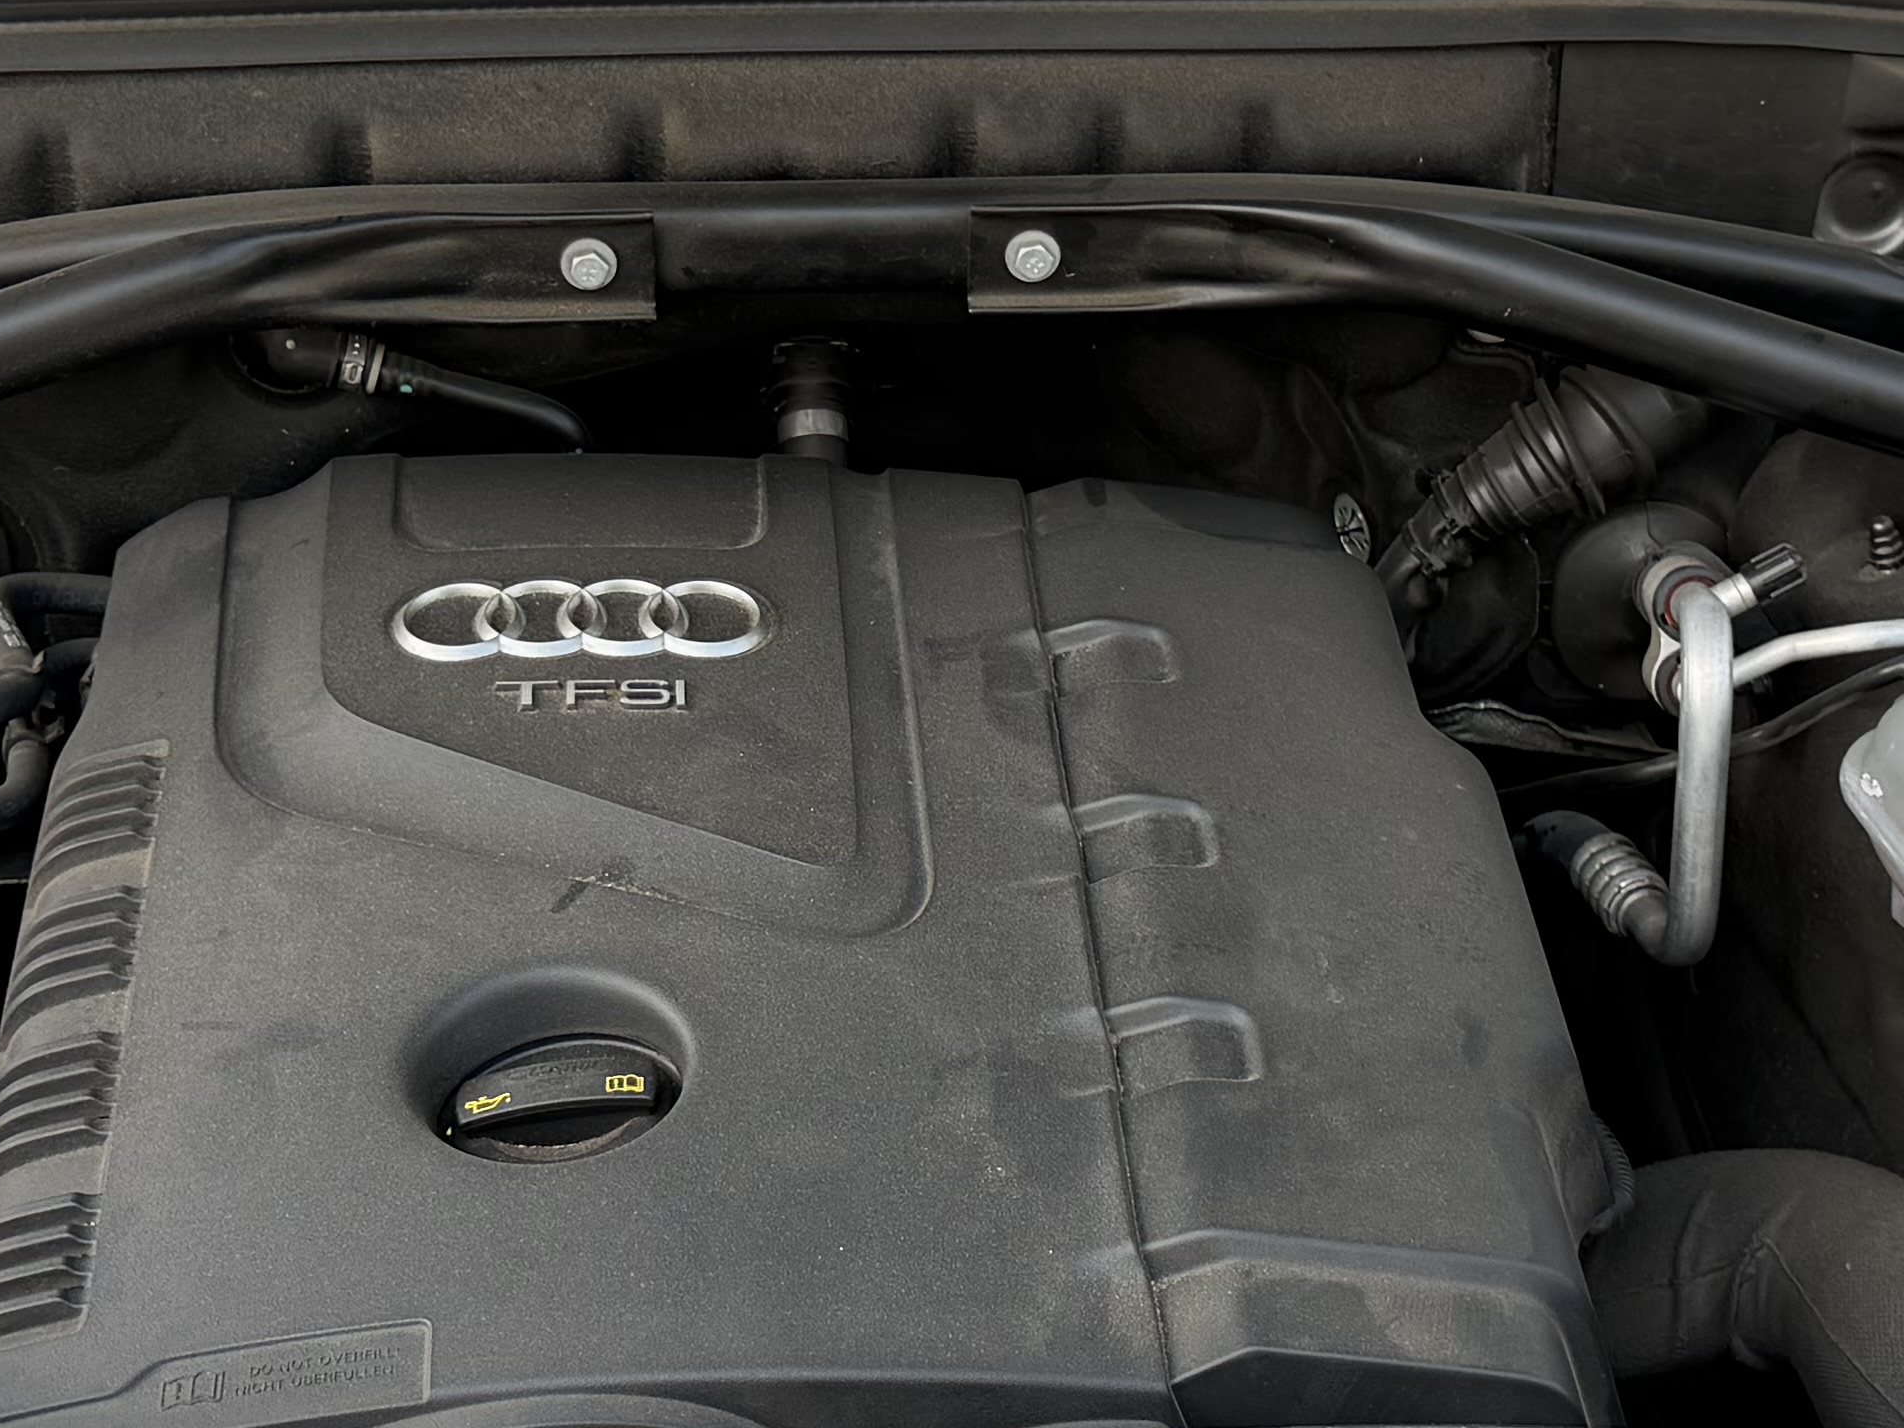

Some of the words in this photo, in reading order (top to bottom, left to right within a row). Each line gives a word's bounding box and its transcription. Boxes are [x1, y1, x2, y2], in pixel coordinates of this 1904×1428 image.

[495, 678, 688, 712] TFSI
[249, 1365, 274, 1378] DO
[279, 1357, 312, 1373] NOT
[234, 1380, 285, 1397] NICHT
